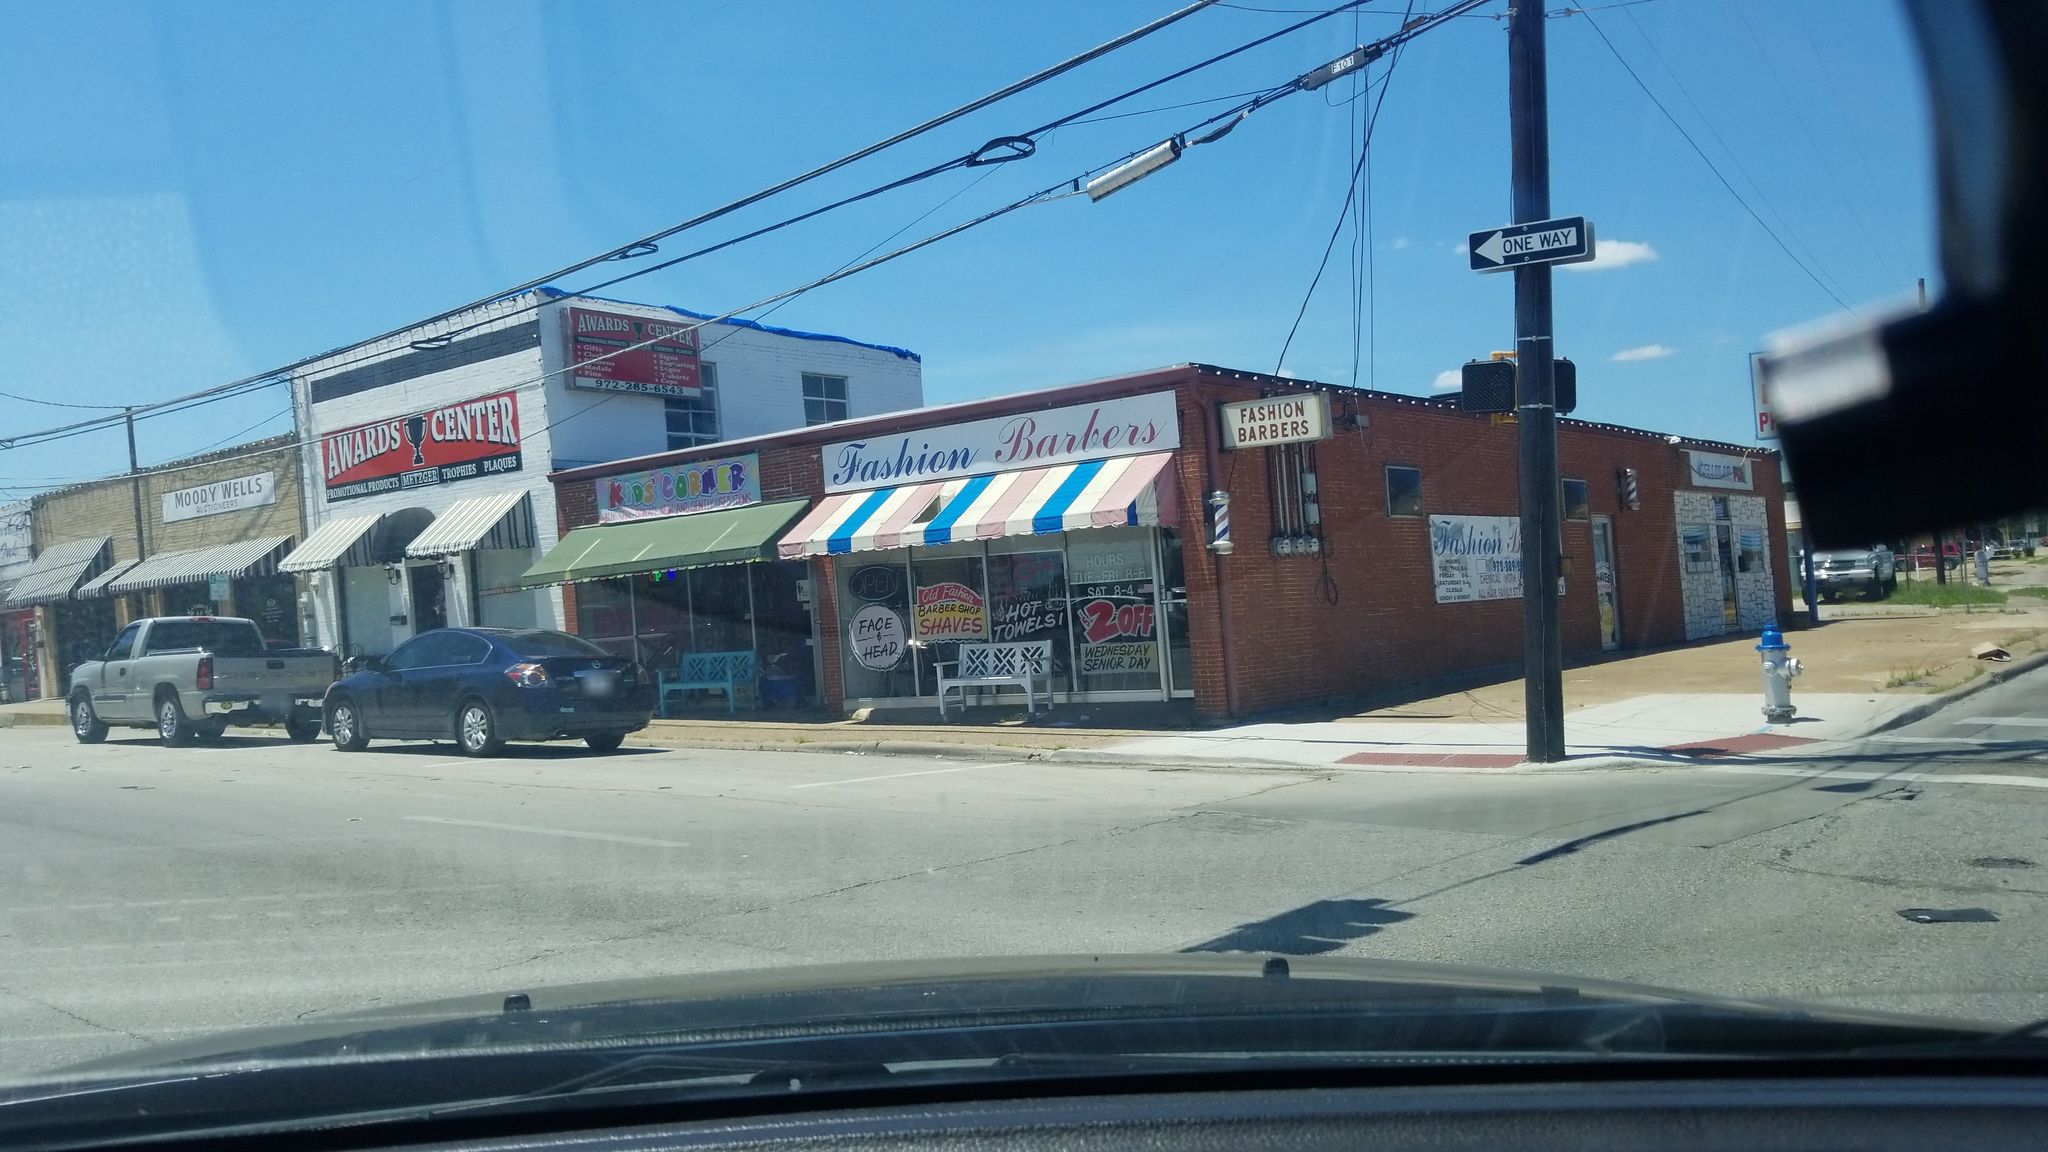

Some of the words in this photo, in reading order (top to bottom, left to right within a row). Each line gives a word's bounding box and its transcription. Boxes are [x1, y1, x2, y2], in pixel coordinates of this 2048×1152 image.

[1503, 236, 1533, 254] ONE
[1539, 229, 1571, 246] WAY
[577, 313, 630, 333] AWARDS
[647, 323, 694, 347] CENTER
[584, 364, 612, 372] Medals
[1240, 401, 1304, 424] FASHION
[328, 421, 400, 480] AWARDS
[431, 396, 518, 446] CENTER
[1238, 420, 1309, 443] BARBERS
[833, 437, 980, 486] Fashion
[995, 409, 1166, 464] Barbers
[326, 485, 367, 500] PROMOTIONAL
[368, 476, 399, 492] PRODUCTS
[401, 470, 438, 486] METZGER
[442, 463, 477, 480] TROPHIES
[484, 456, 517, 474] PLAQUES
[661, 462, 746, 501] CORNER
[175, 486, 217, 509] MOODY
[221, 477, 262, 500] WELLS
[196, 500, 239, 514] AUCTIONEERS
[1435, 520, 1502, 556] Fashion
[1086, 553, 1124, 567] HOURS
[1126, 568, 1146, 579] 8-6
[921, 587, 940, 602] Old
[943, 586, 974, 604] Fashion
[1087, 587, 1107, 598] SAT
[1113, 584, 1134, 596] 8-4
[917, 604, 956, 617] BARBER
[957, 604, 981, 615] SHOP
[1005, 600, 1041, 623] HOT
[859, 617, 893, 635] FACE
[919, 617, 983, 636] SHAVES
[863, 641, 897, 661] HEAD
[1085, 643, 1150, 658] WEDNESDAY
[1083, 657, 1124, 671] SENIOR
[1128, 655, 1151, 670] DAY
